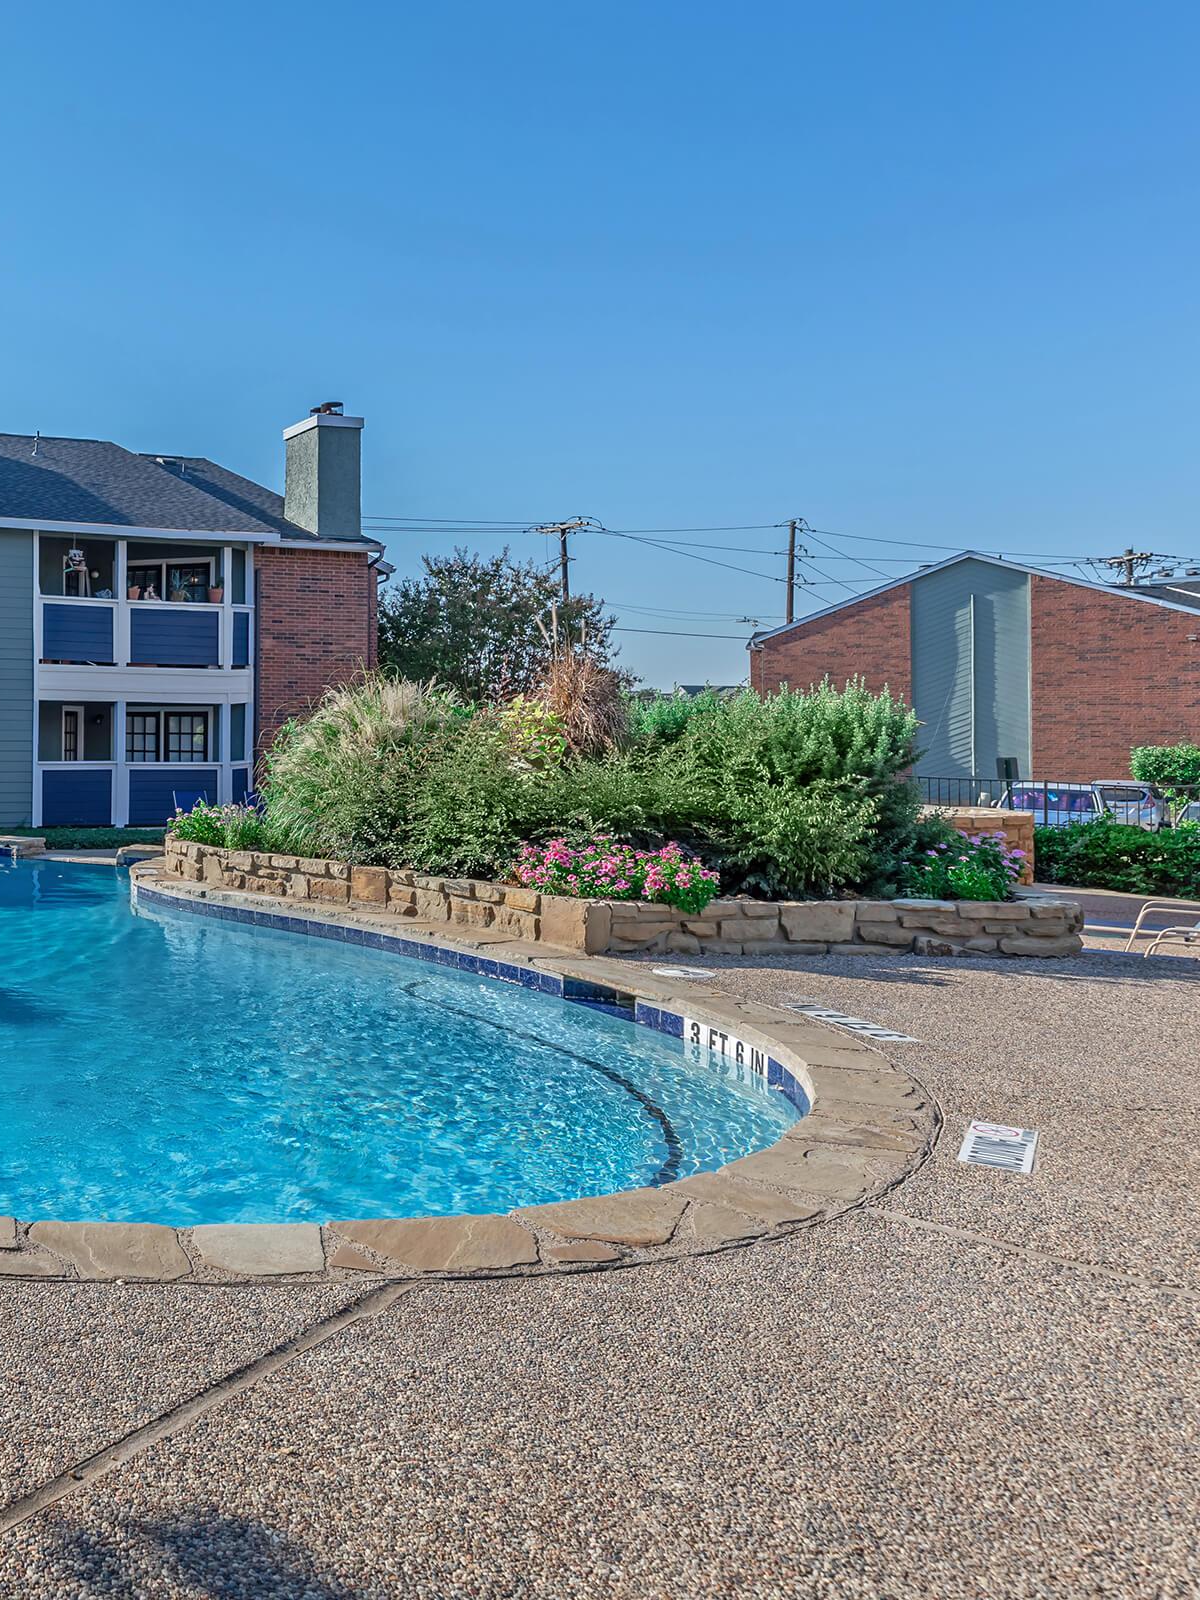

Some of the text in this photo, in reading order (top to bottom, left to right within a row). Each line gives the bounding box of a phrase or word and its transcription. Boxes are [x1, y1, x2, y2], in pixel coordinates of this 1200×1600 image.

[690, 1022, 764, 1075] 3 FT 6 IN
